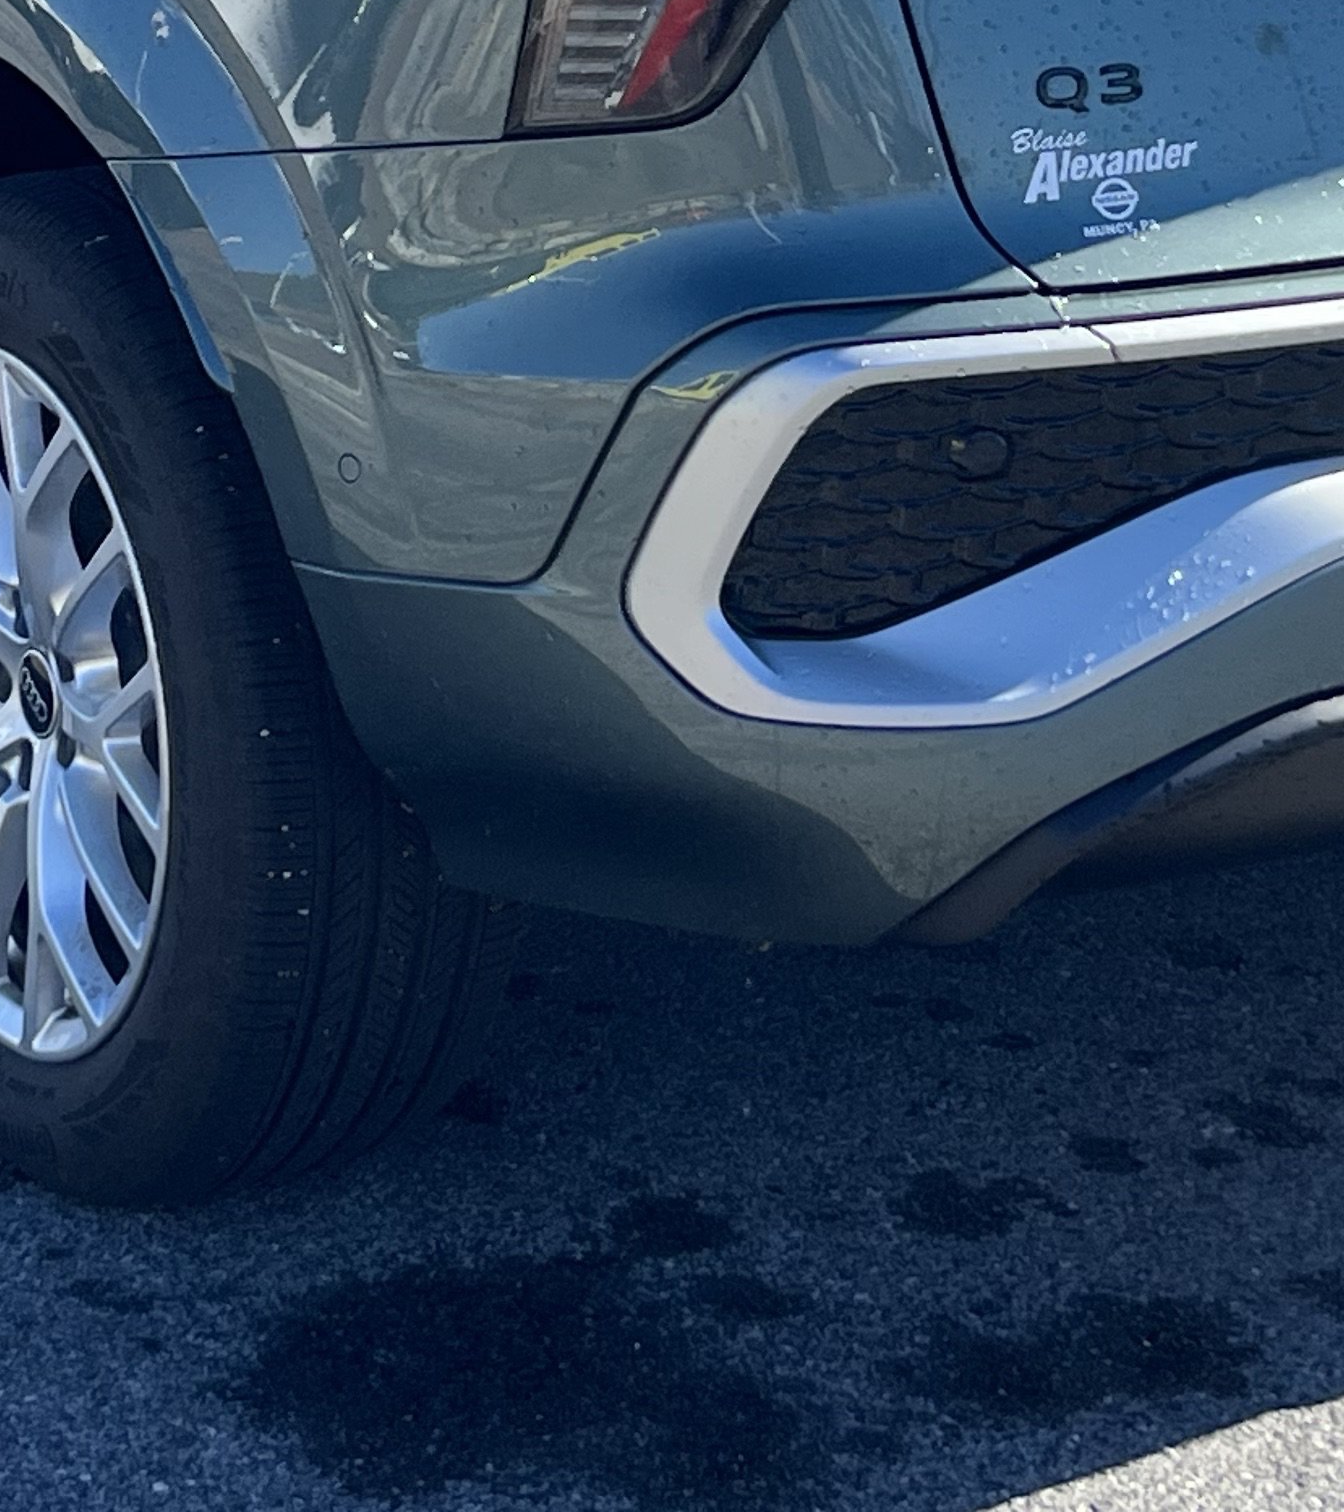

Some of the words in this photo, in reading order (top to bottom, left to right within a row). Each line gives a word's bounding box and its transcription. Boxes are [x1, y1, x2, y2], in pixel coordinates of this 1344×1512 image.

[1035, 62, 1144, 113] Q3
[1010, 126, 1088, 154] Blaise
[1023, 138, 1198, 205] Alexander
